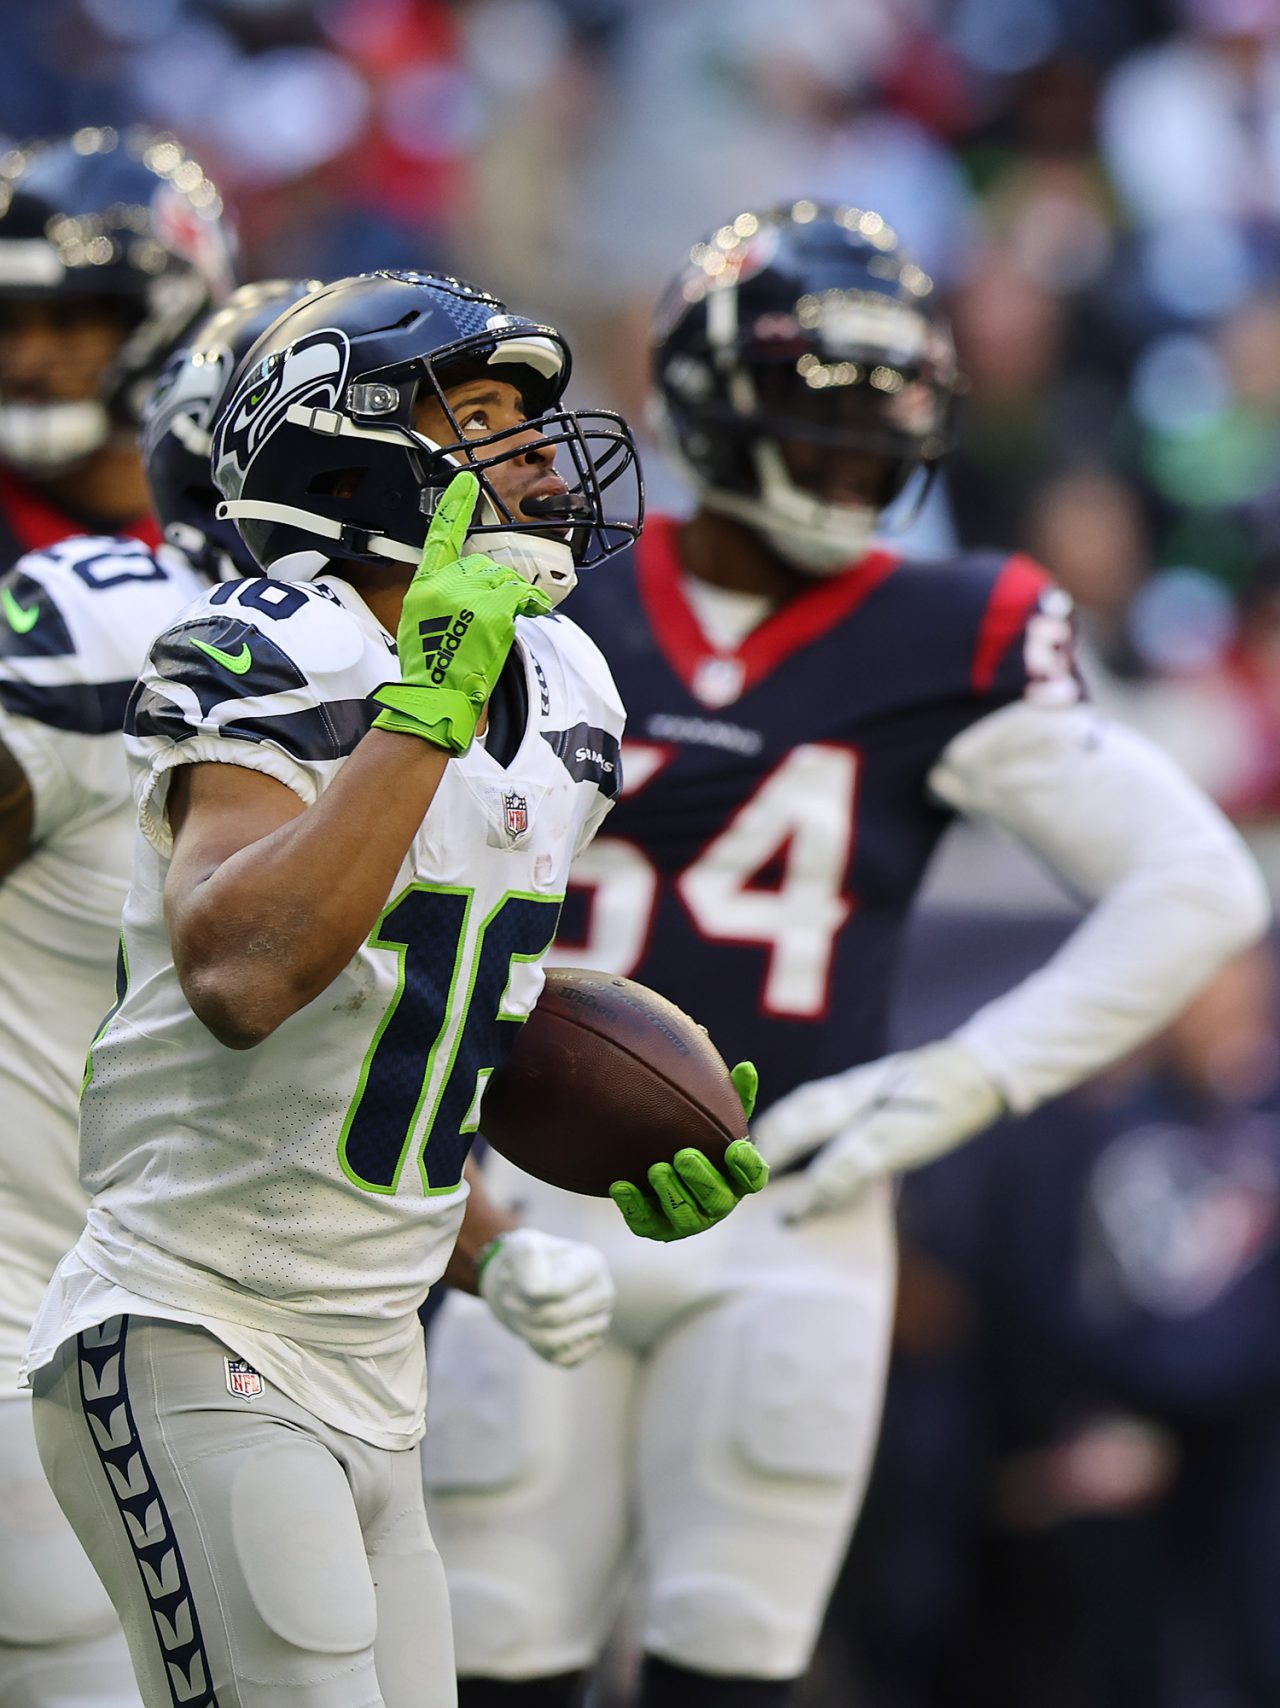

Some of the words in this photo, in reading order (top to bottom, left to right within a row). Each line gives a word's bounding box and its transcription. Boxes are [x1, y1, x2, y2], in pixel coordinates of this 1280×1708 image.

[431, 608, 475, 685] adidas
[336, 881, 567, 1197] 16
[232, 1374, 260, 1394] NFL
